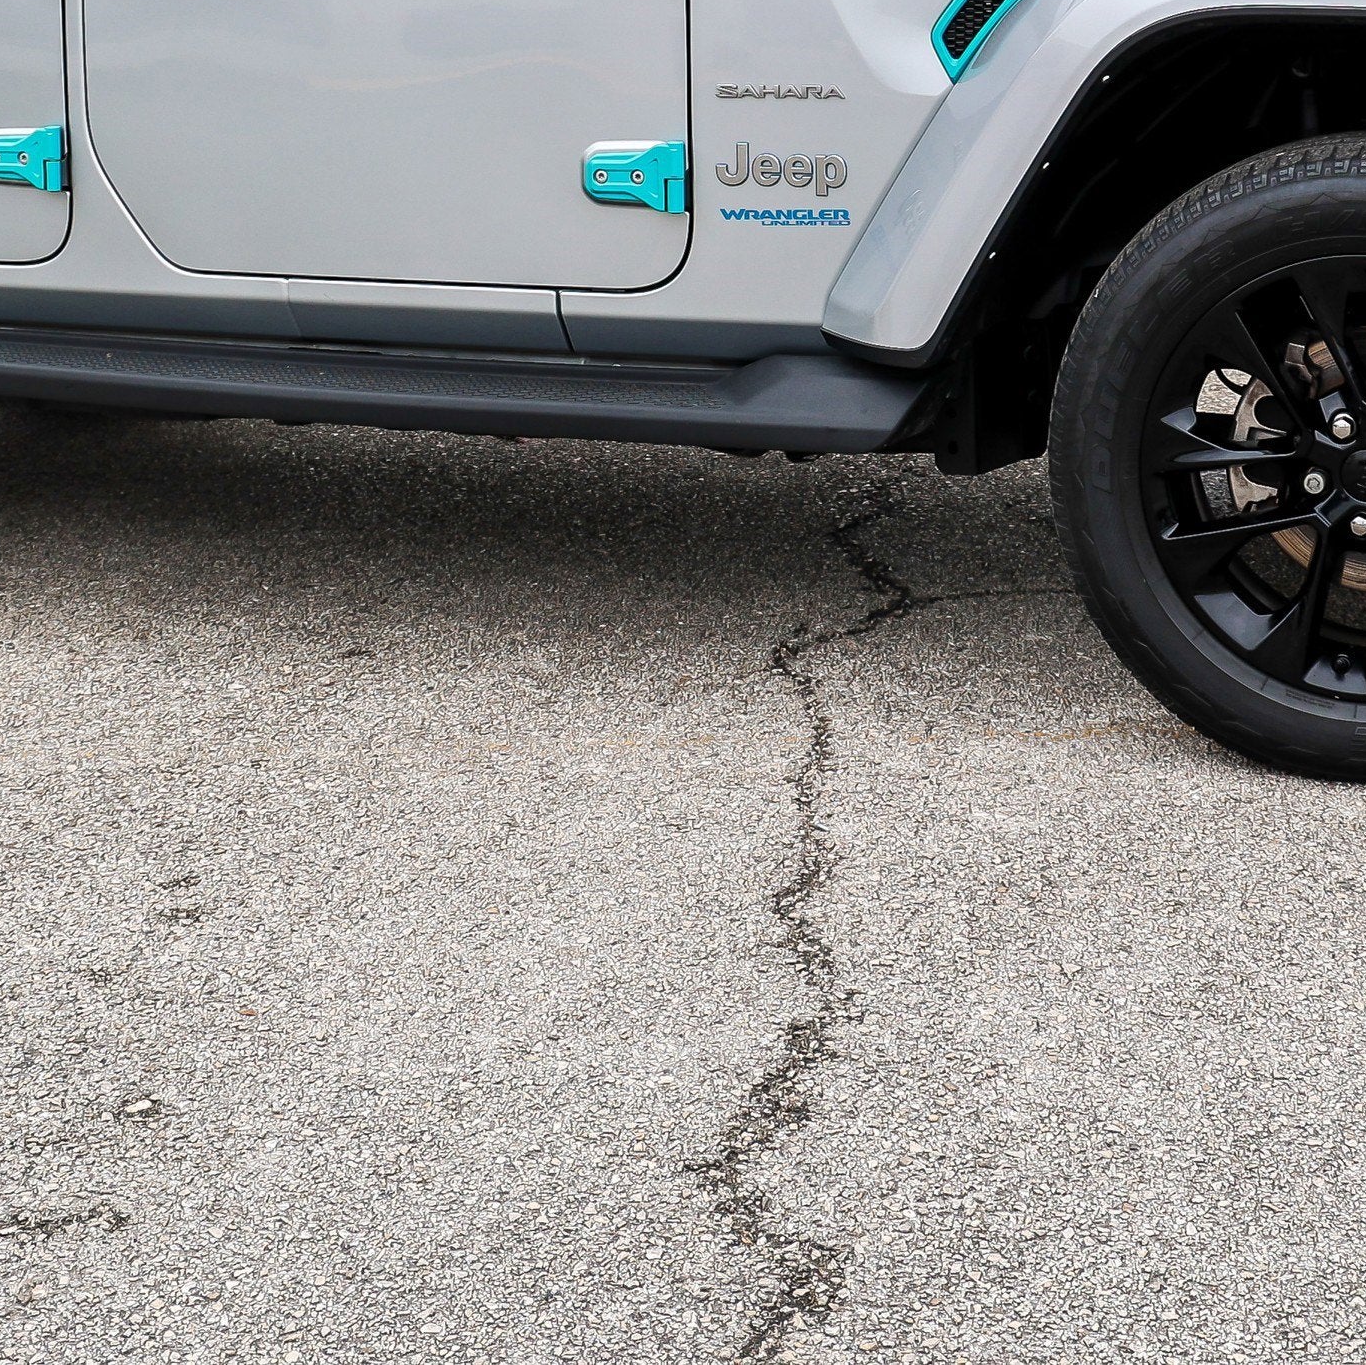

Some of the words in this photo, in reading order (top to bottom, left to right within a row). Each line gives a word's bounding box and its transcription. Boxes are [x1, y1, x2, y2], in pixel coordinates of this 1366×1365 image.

[715, 83, 847, 100] SAHARA
[715, 141, 848, 197] Jeep
[719, 208, 851, 221] WRANGLER
[761, 219, 851, 227] UNLIMITED
